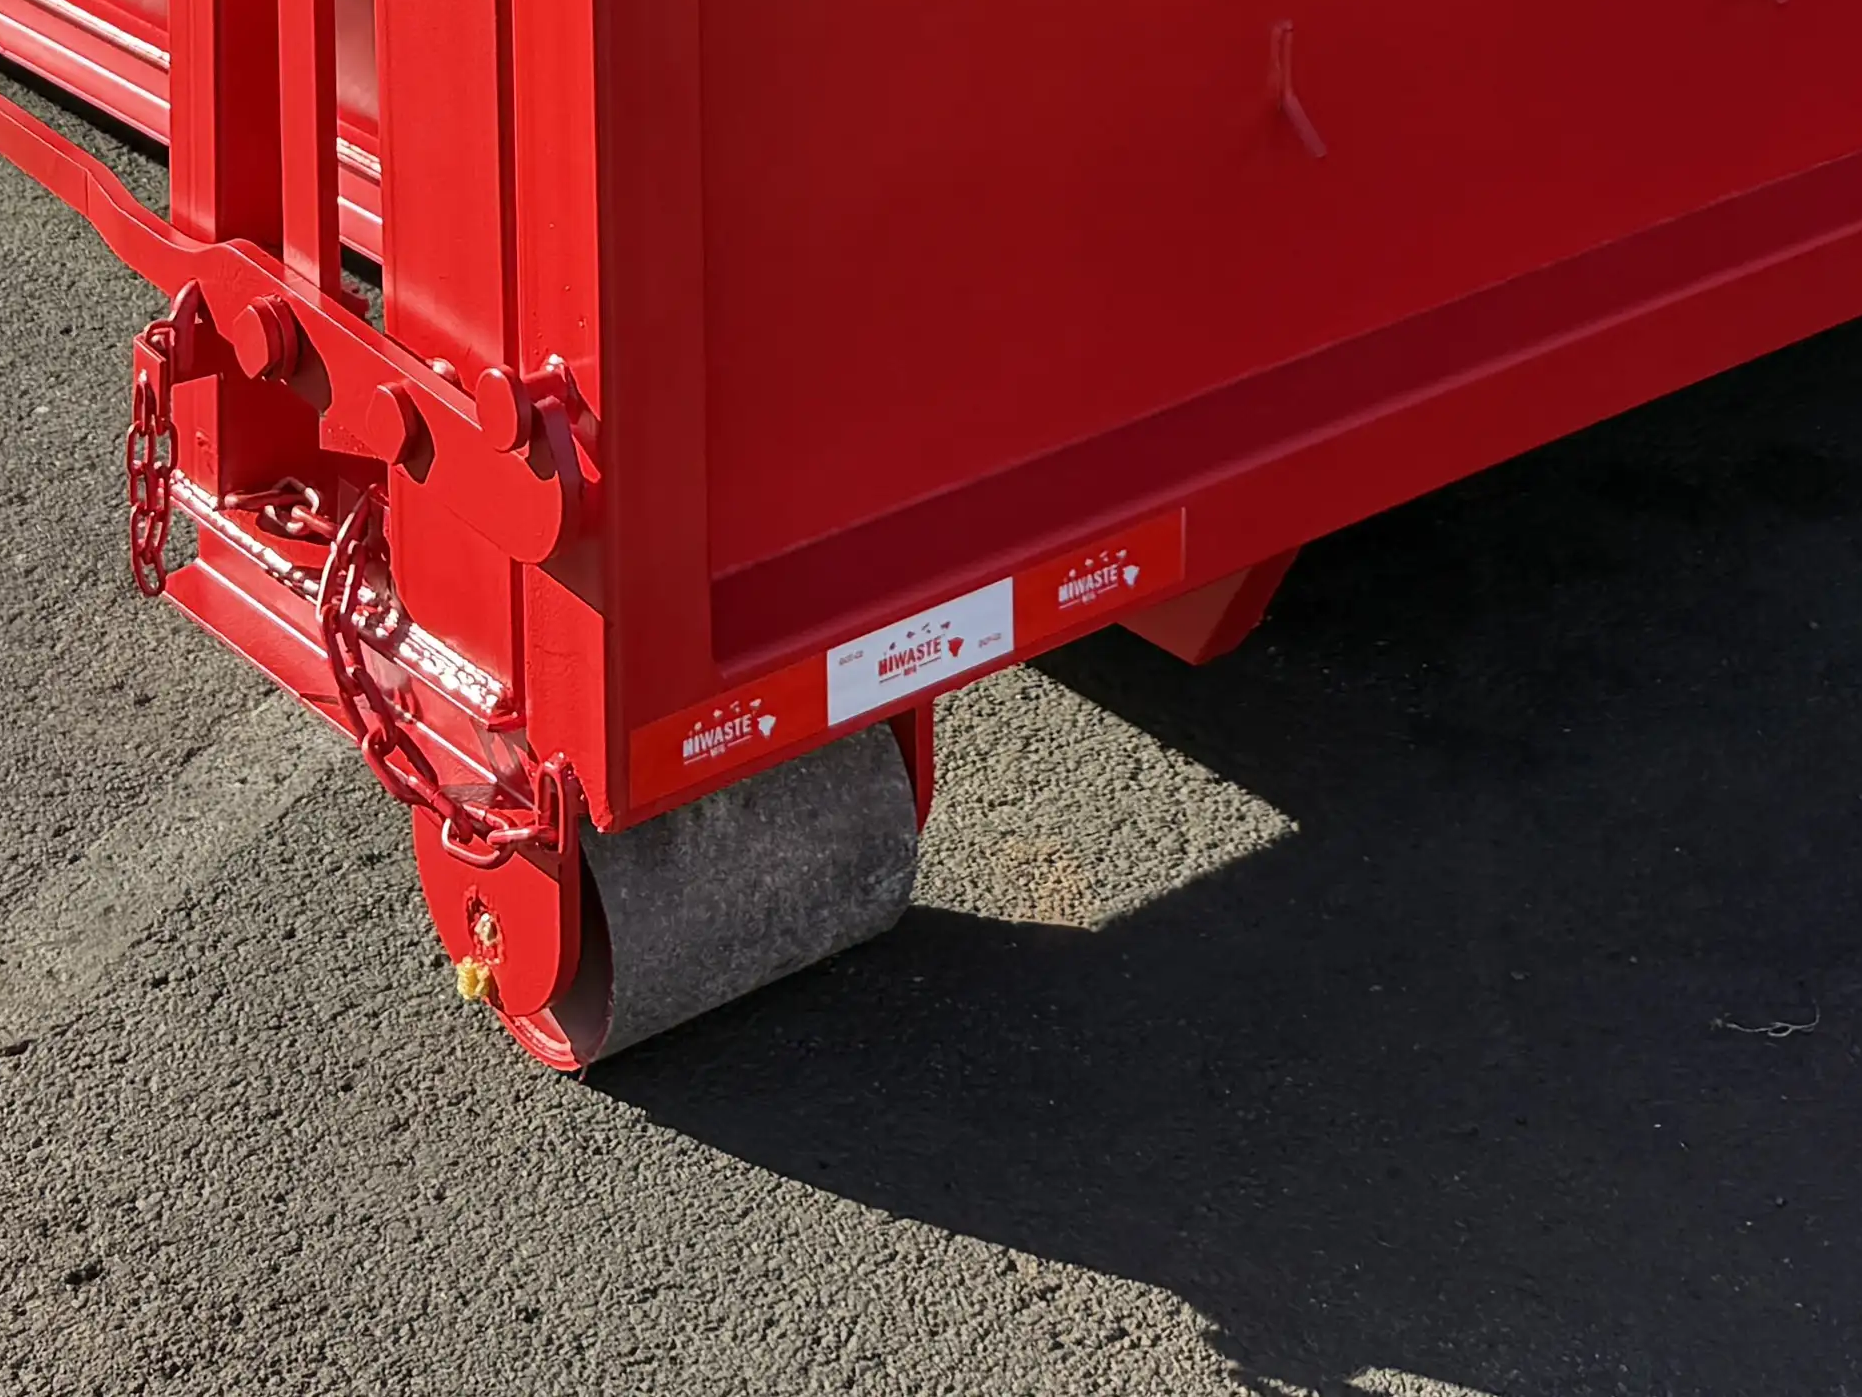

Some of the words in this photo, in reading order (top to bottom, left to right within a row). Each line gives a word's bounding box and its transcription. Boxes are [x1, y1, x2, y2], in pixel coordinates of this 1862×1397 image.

[1058, 564, 1118, 602] HIWASTE
[878, 635, 941, 676] HIWASTE
[682, 714, 752, 758] HIWASTE
